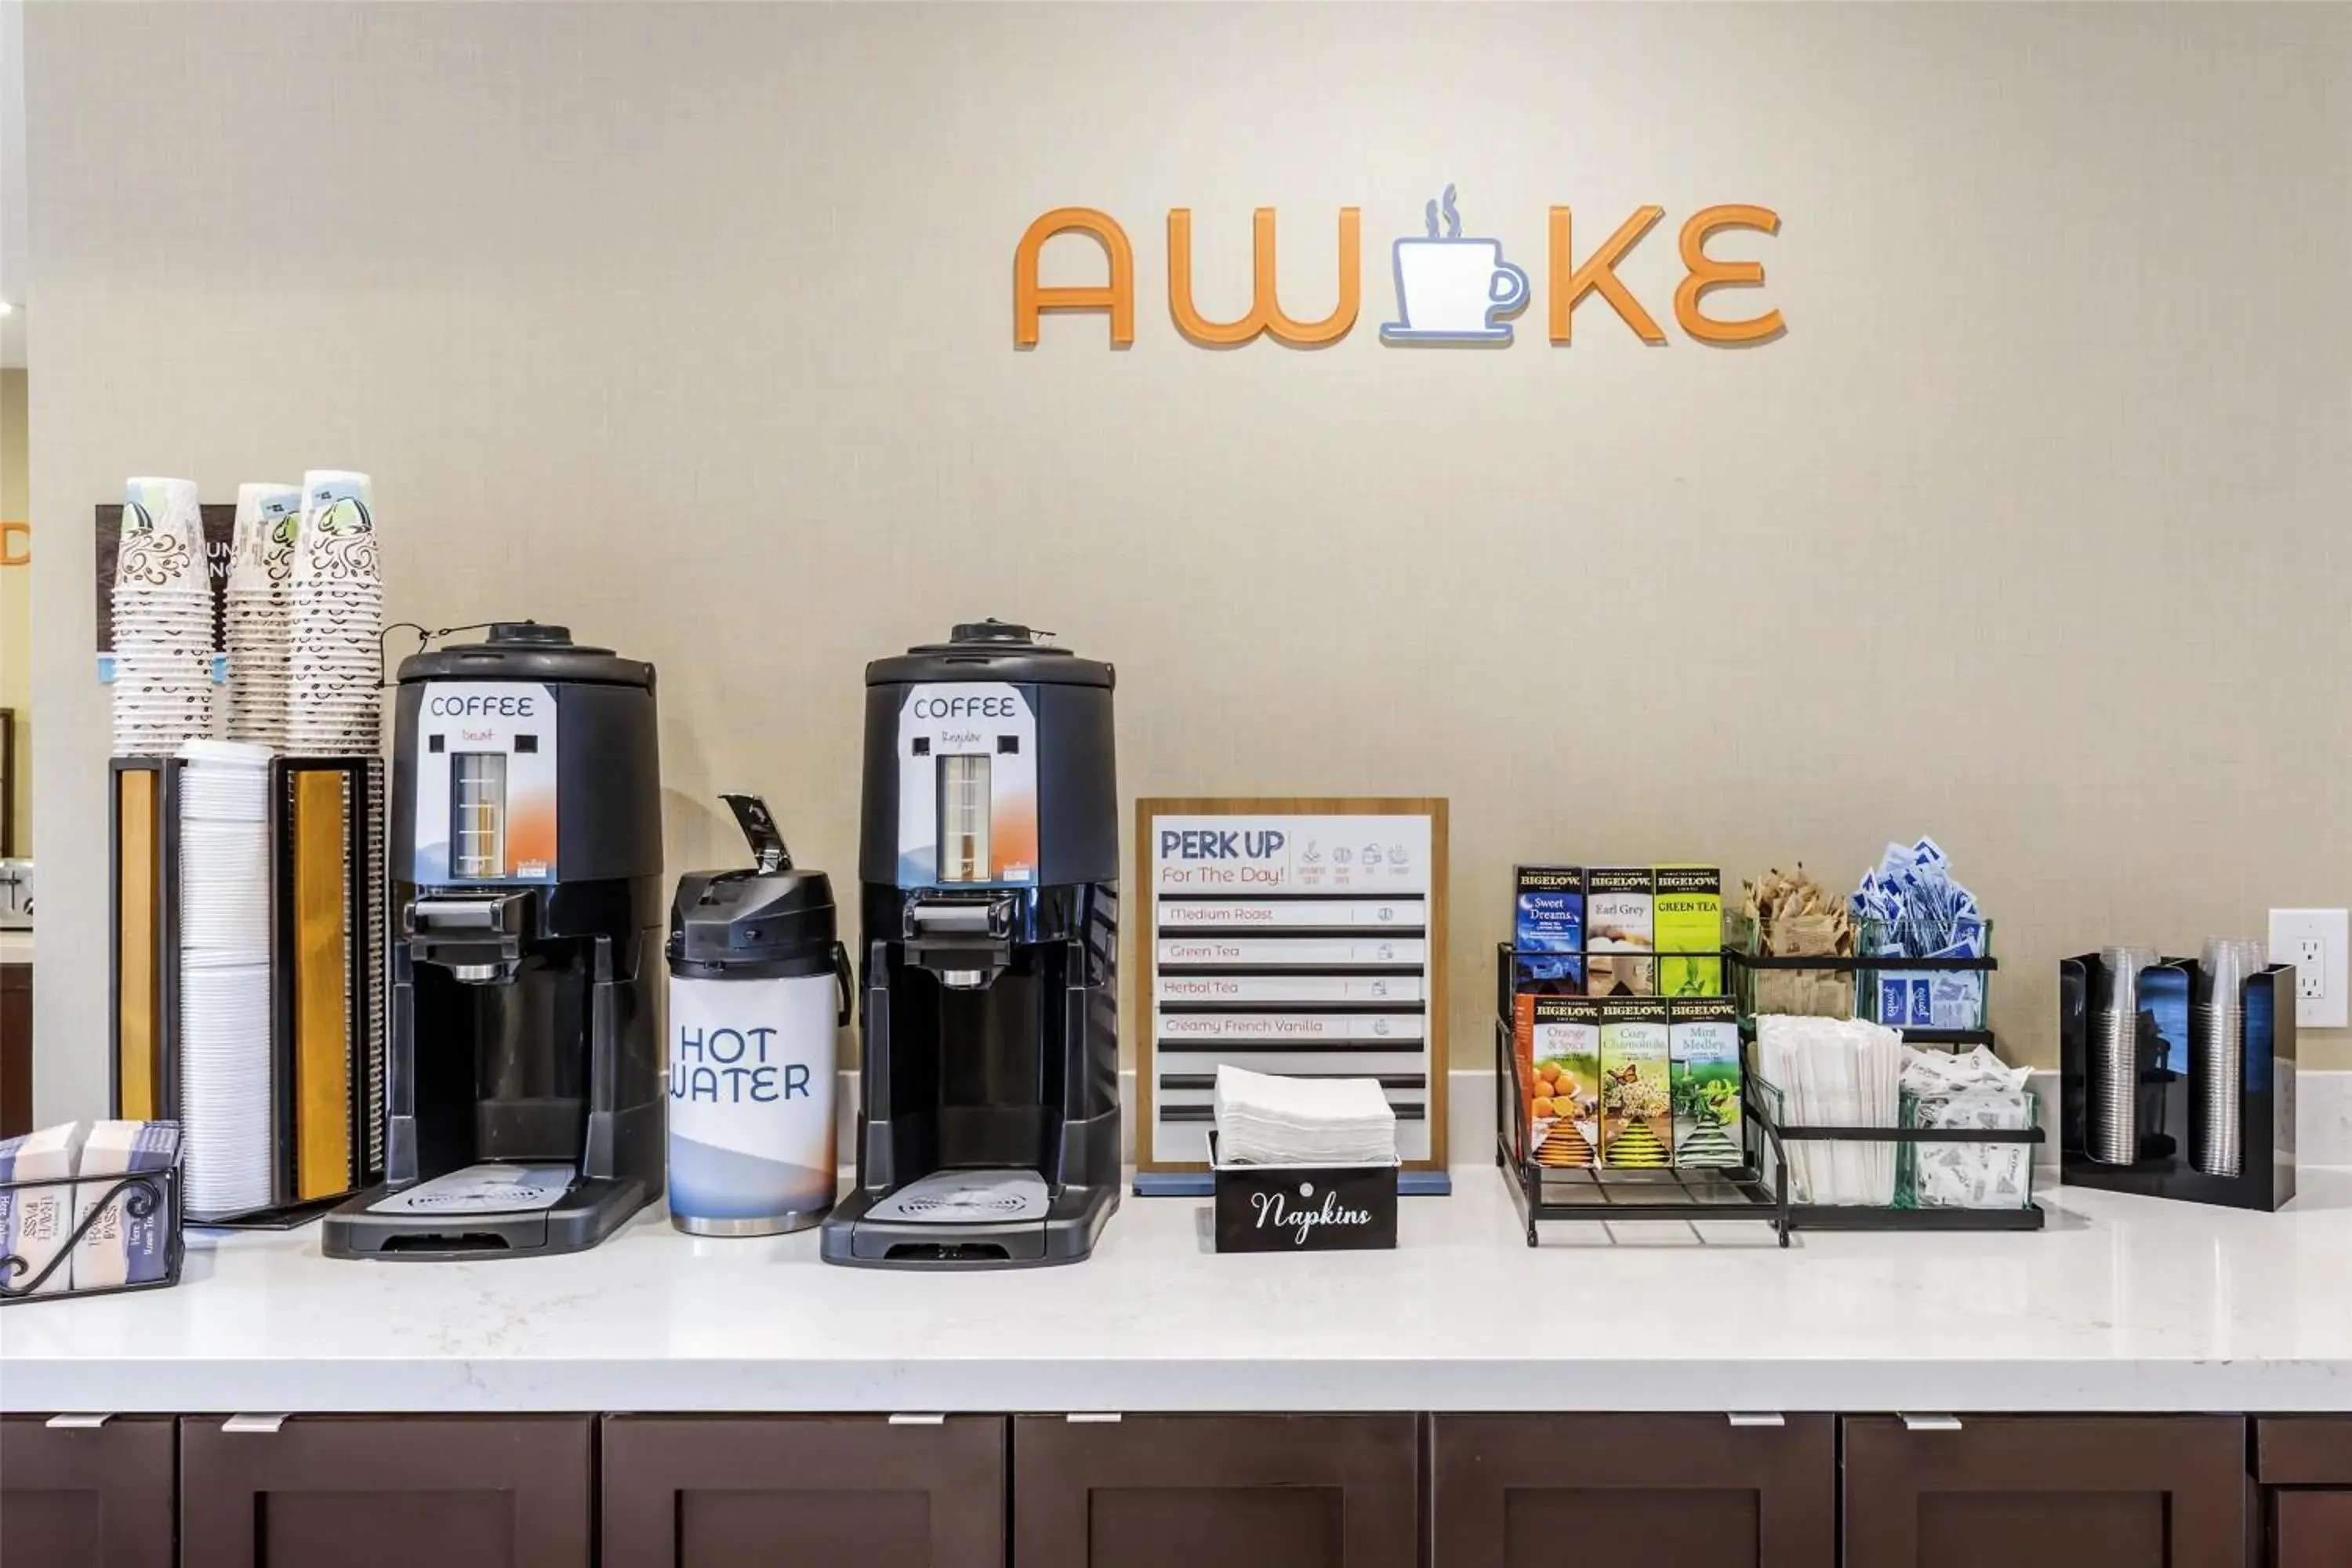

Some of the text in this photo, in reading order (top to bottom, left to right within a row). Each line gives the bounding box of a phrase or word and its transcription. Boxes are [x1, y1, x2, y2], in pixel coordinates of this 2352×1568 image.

[431, 696, 535, 717] COFFEE
[913, 696, 1016, 719] COFFEE
[1160, 829, 1285, 860] PERK UP
[1162, 866, 1192, 883] For
[1198, 866, 1236, 883] The
[1240, 866, 1284, 887] Day!
[1534, 898, 1564, 909] Sweet
[1658, 902, 1718, 912] GREEN TEA
[1171, 908, 1272, 920] Medium Roast
[1530, 909, 1573, 920] Dreams
[1595, 904, 1645, 918] Earl Grey
[1170, 945, 1240, 957] Green Tea
[1163, 982, 1238, 993] Herbal Tea
[1166, 1020, 1323, 1034] Creamy French Vanilla
[1690, 1027, 1718, 1037] Mint
[681, 1025, 778, 1064] HOT
[671, 1062, 810, 1102] WATER
[1251, 1191, 1372, 1245] Napkins
